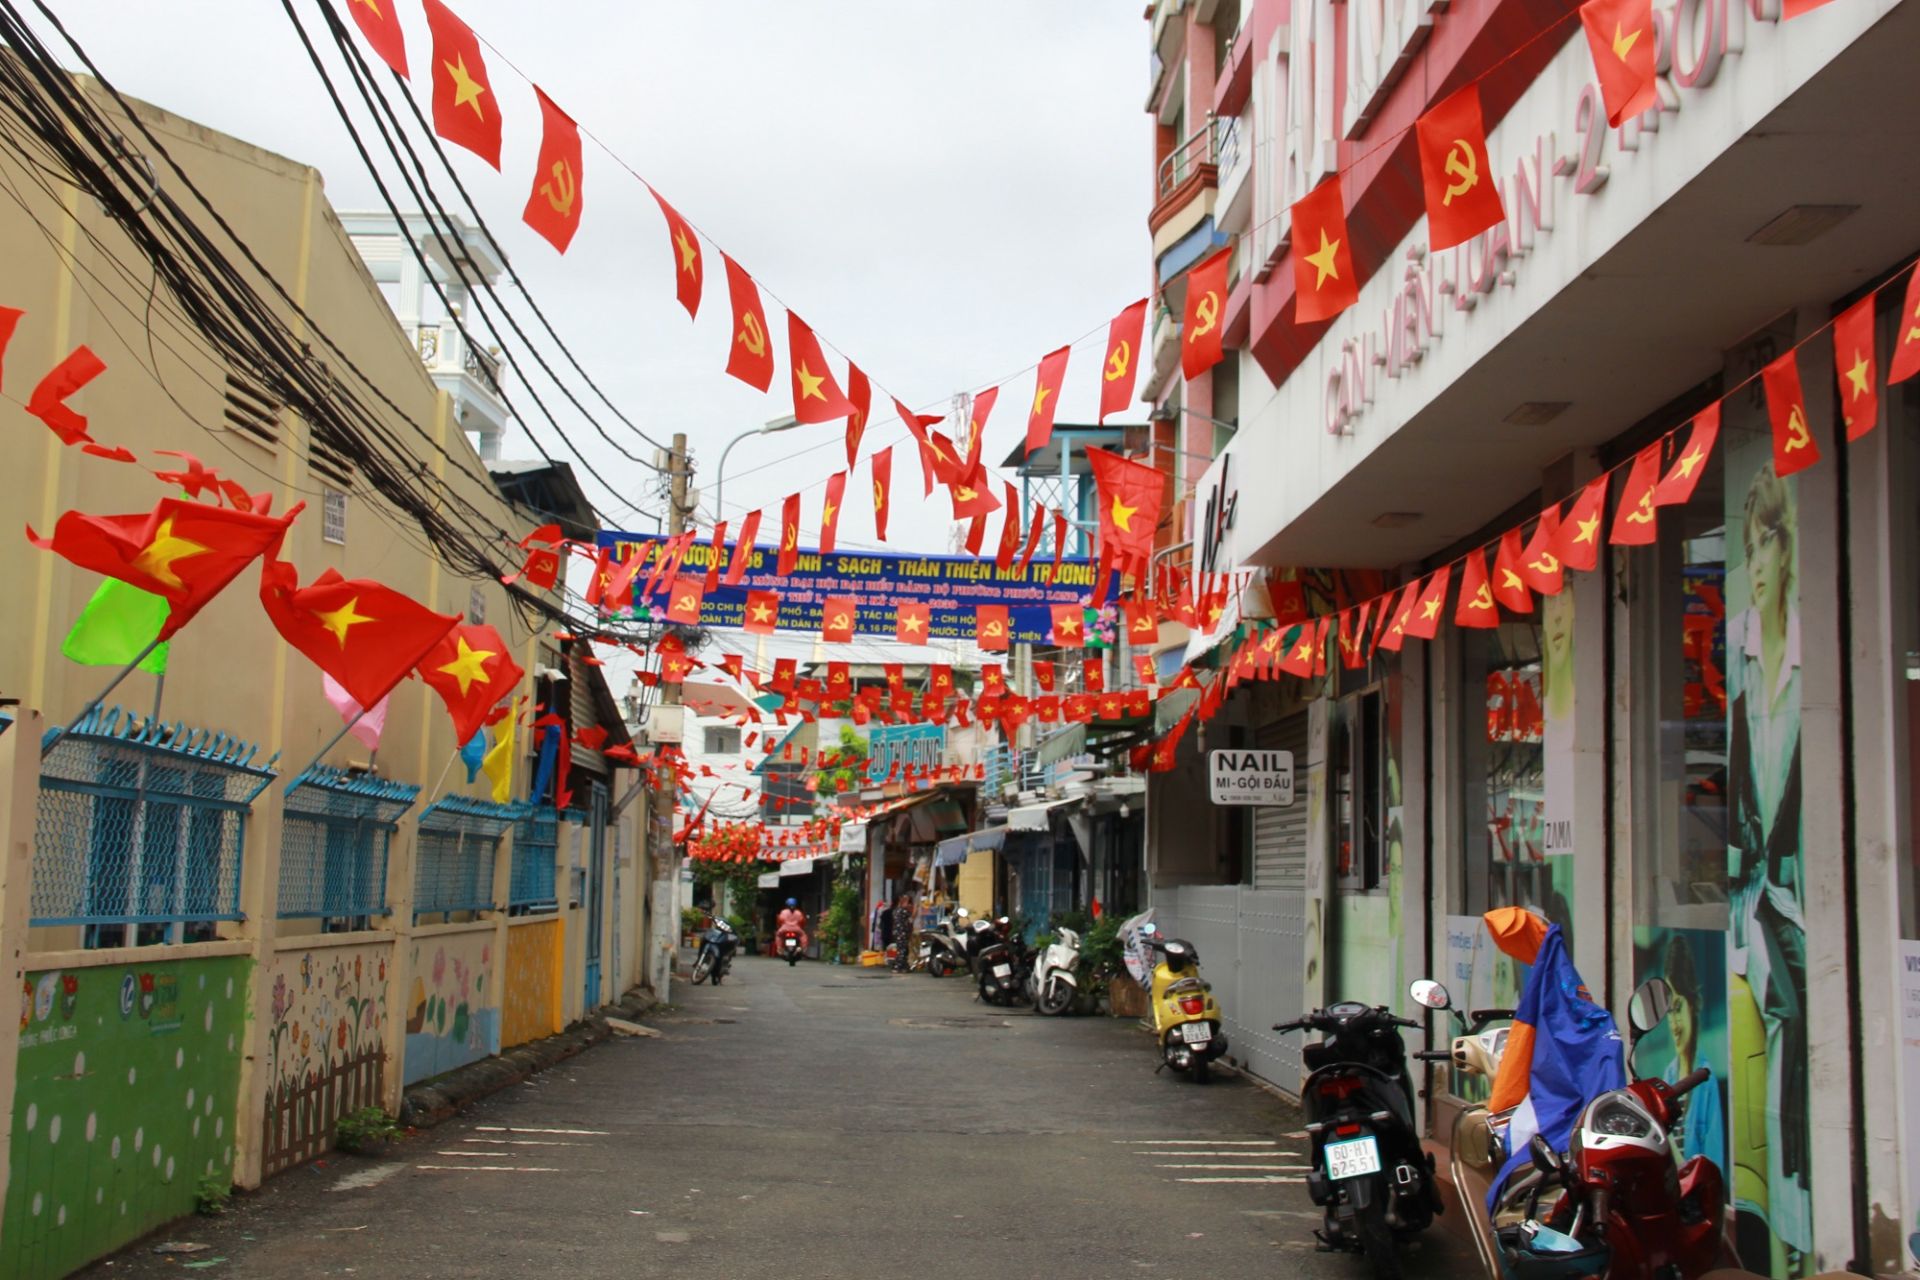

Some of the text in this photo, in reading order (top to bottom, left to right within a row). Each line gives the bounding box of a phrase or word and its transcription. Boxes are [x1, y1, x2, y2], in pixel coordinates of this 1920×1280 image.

[838, 557, 882, 577] SẠCH
[898, 558, 940, 577] THÂN
[945, 560, 991, 583] THIỆN
[1046, 591, 1079, 602] LONG
[1218, 753, 1288, 772] NAIL
